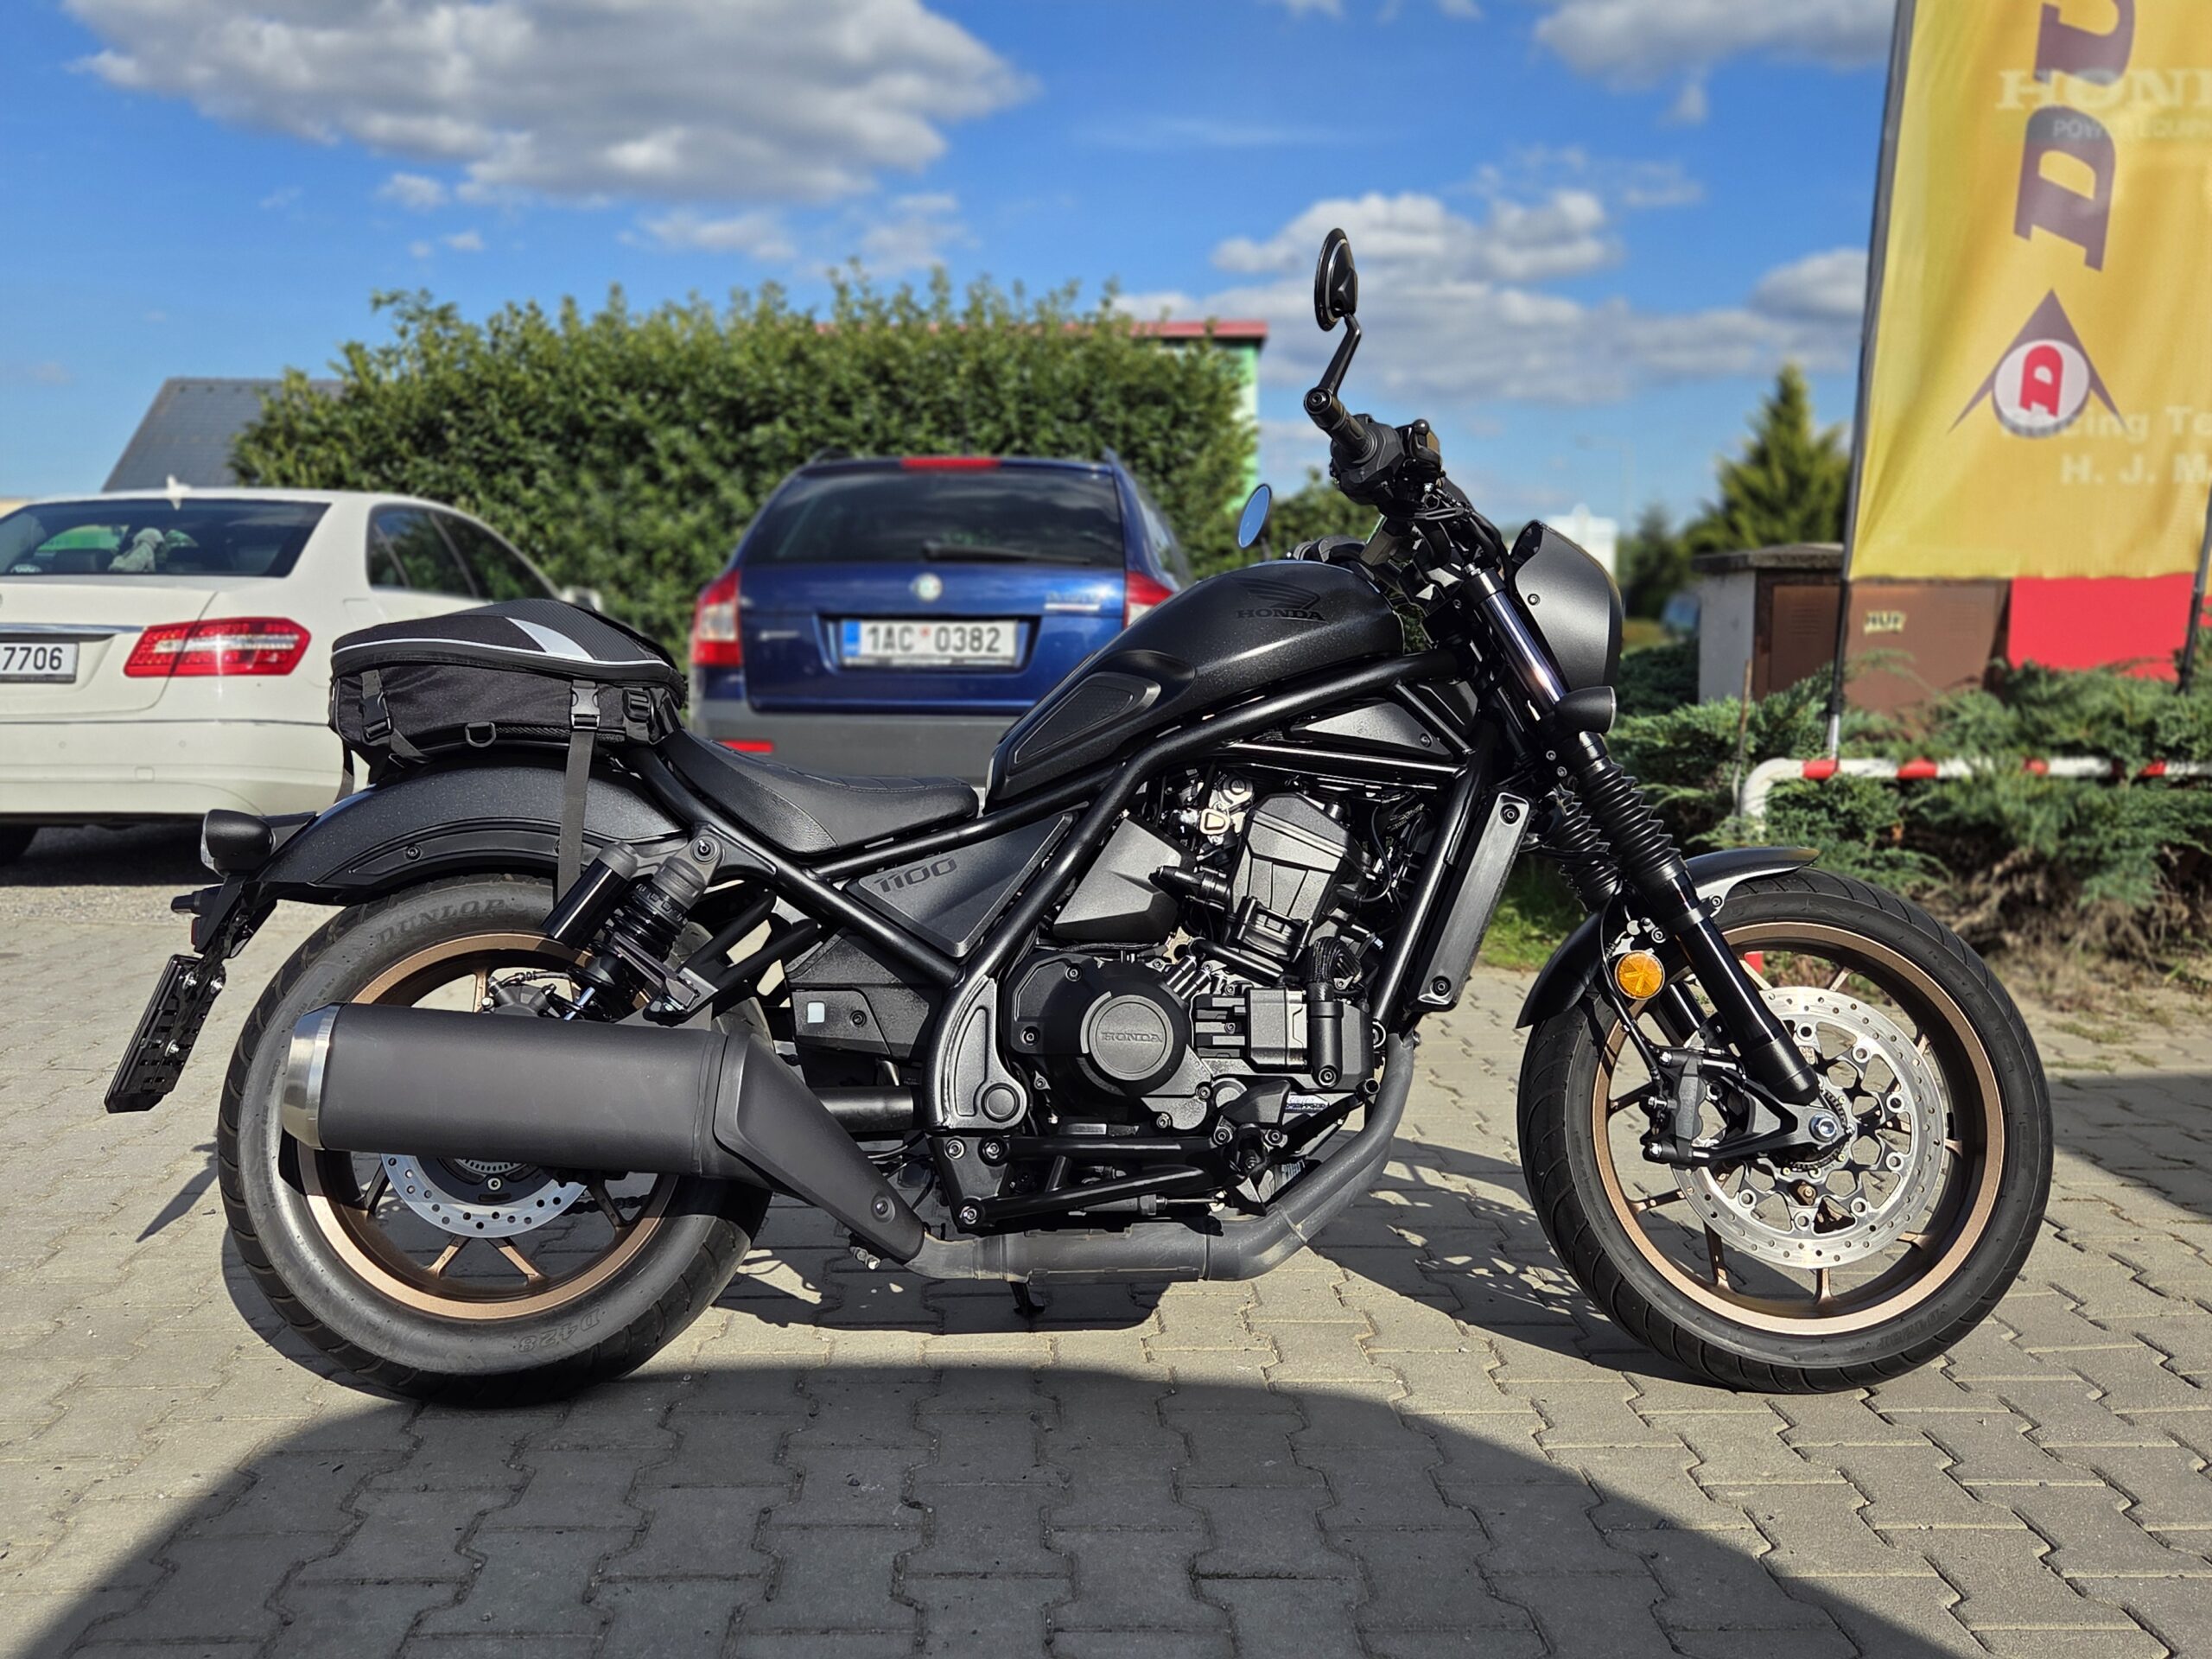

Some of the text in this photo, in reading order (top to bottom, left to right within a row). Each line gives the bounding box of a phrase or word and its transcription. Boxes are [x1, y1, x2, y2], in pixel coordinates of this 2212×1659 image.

[2172, 452, 2212, 485] M
[1236, 607, 1327, 622] HONDA
[868, 626, 1001, 652] 1AC 0382
[2, 646, 63, 671] 7706
[873, 856, 957, 893] 1100
[377, 898, 505, 946] DUNLOP
[1100, 1031, 1164, 1044] HONDA
